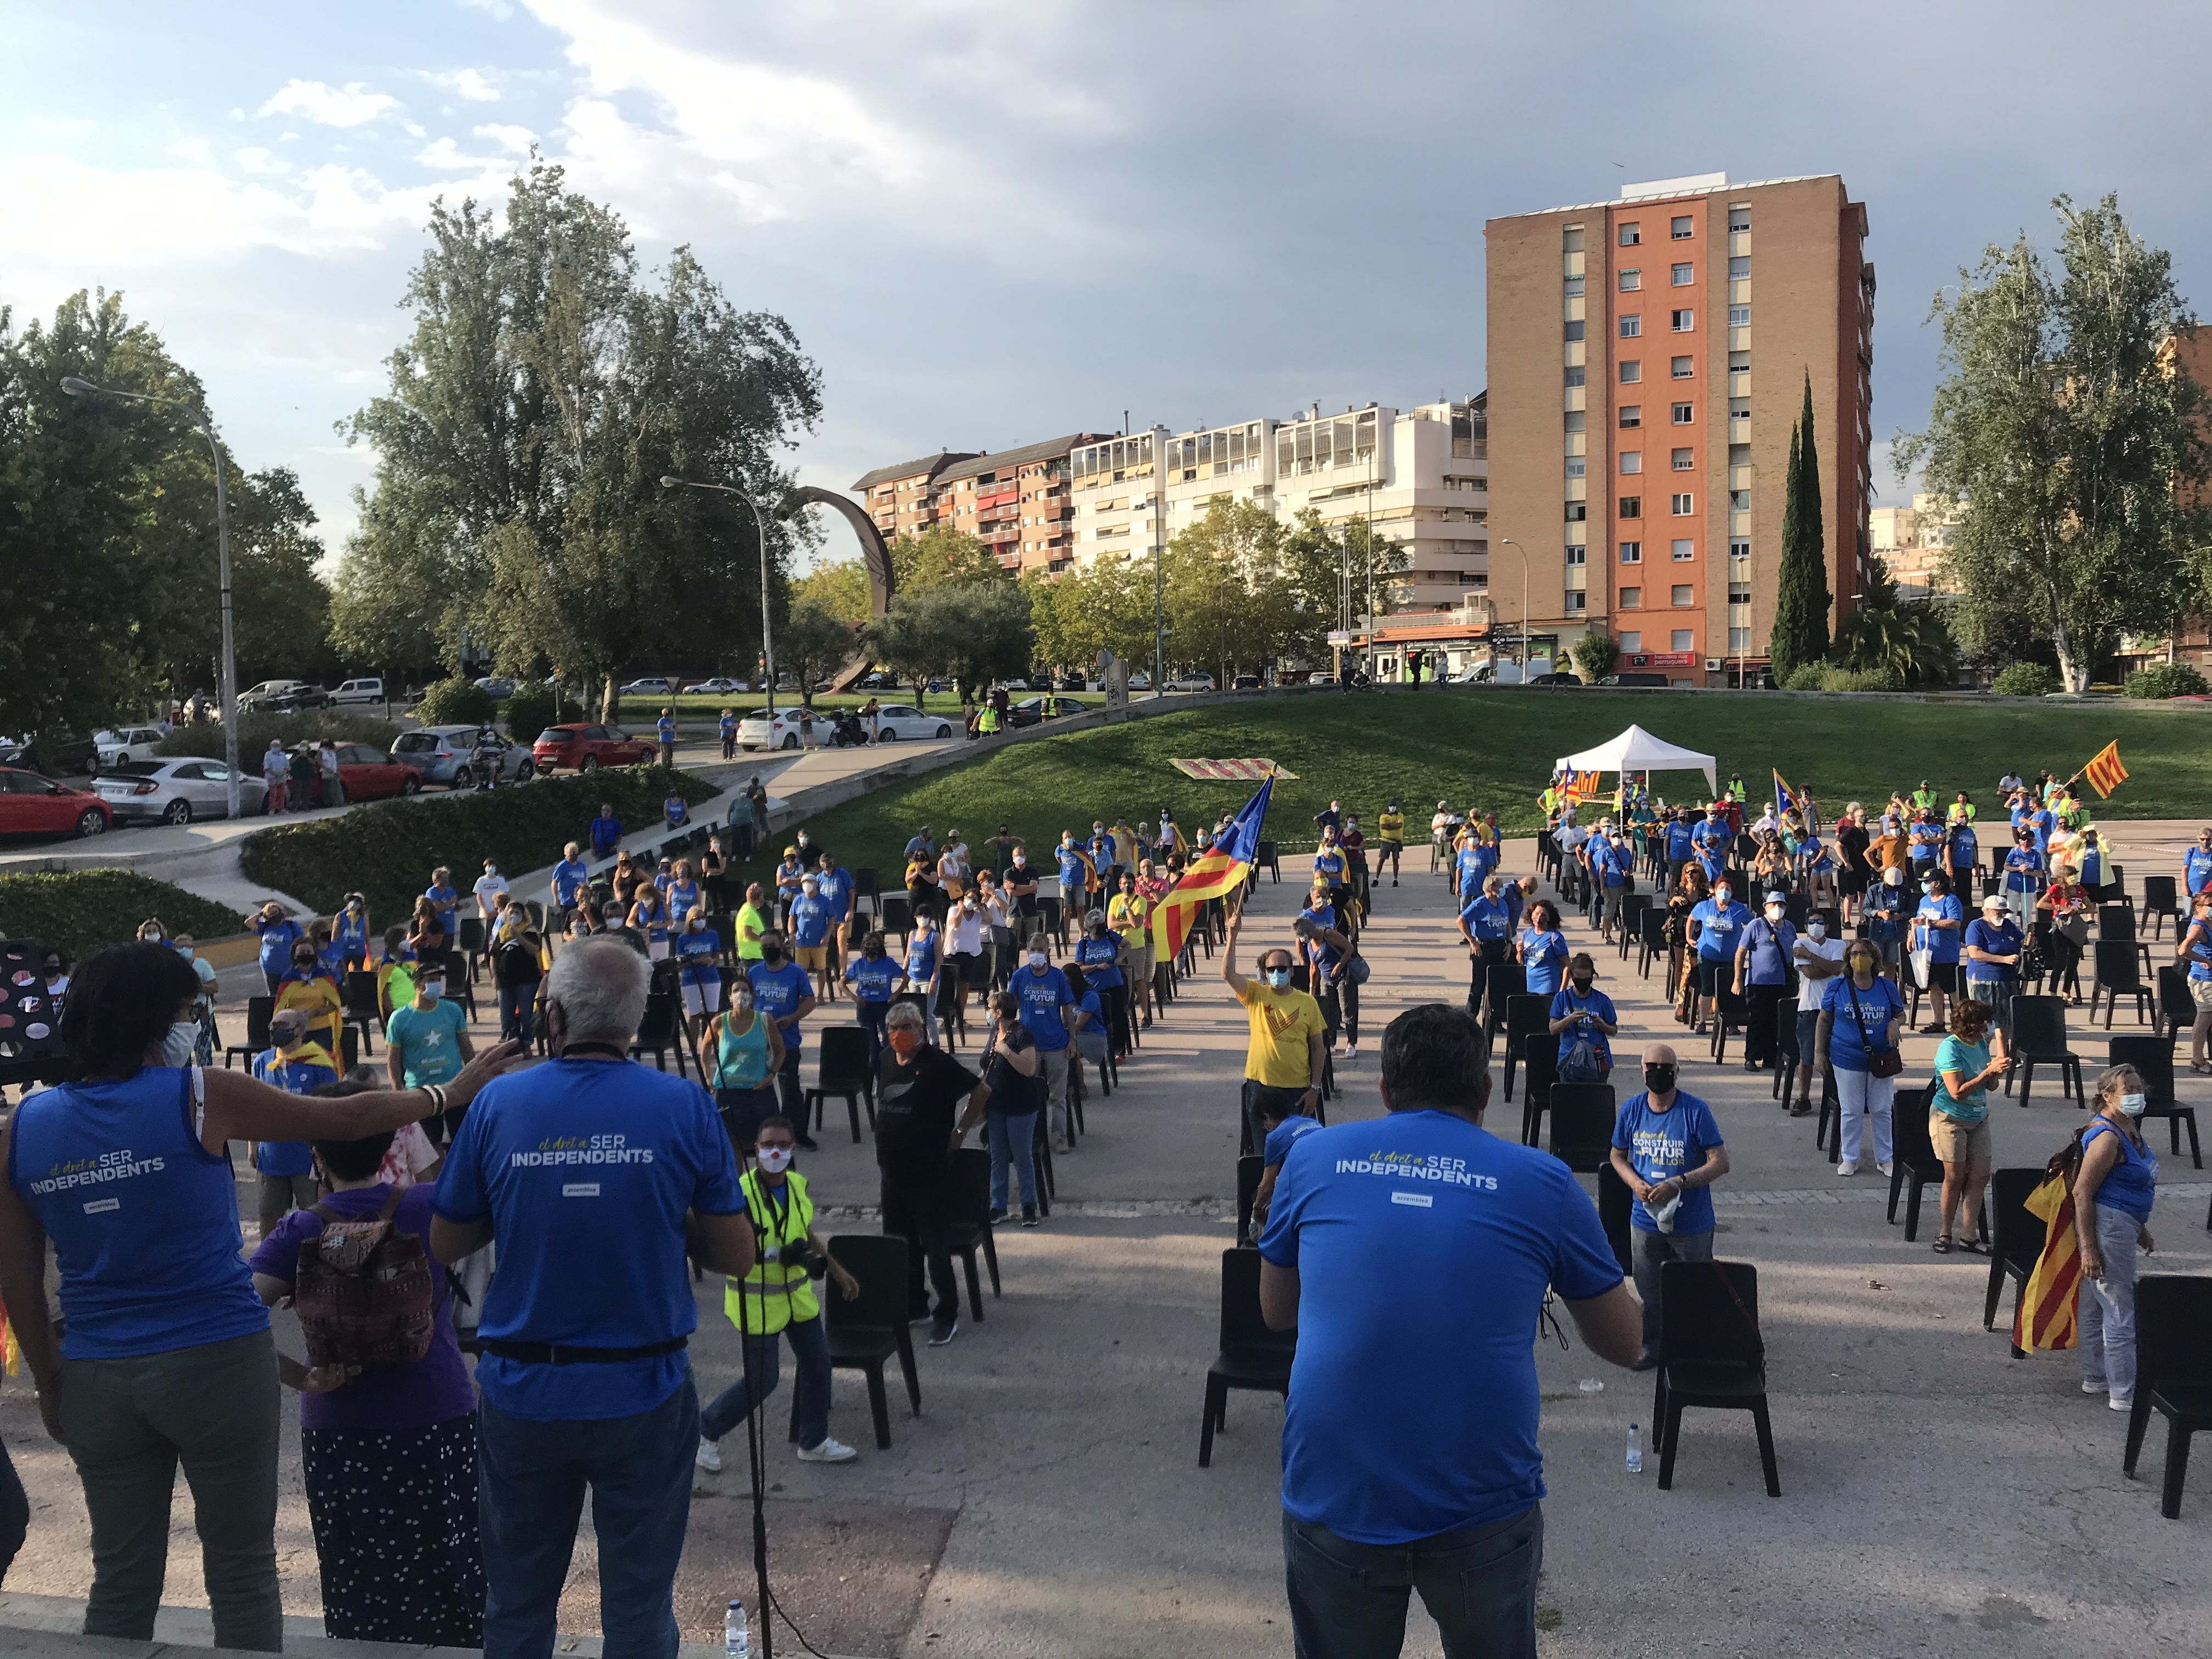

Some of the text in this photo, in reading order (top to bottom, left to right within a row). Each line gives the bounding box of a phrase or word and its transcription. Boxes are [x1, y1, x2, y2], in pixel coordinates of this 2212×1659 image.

[759, 990, 787, 999] FUTUR
[1029, 994, 1056, 1002] FUTUR
[539, 1137, 549, 1150] el
[552, 1136, 576, 1150] dret
[590, 1135, 625, 1149] SER
[1633, 1138, 1684, 1148] CONSTRUIR
[511, 1149, 653, 1167] INDEPENDENTS
[1641, 1147, 1685, 1159] FUTUR
[50, 1163, 59, 1176] el
[63, 1159, 85, 1173] dret
[99, 1149, 133, 1167] SER
[1369, 1150, 1381, 1161] el
[1384, 1151, 1413, 1164] dret
[1426, 1155, 1466, 1172] SER
[1651, 1156, 1685, 1166] MILLOR
[31, 1157, 165, 1195] INDEPENDENTS
[1335, 1160, 1498, 1190] INDEPENDENTS
